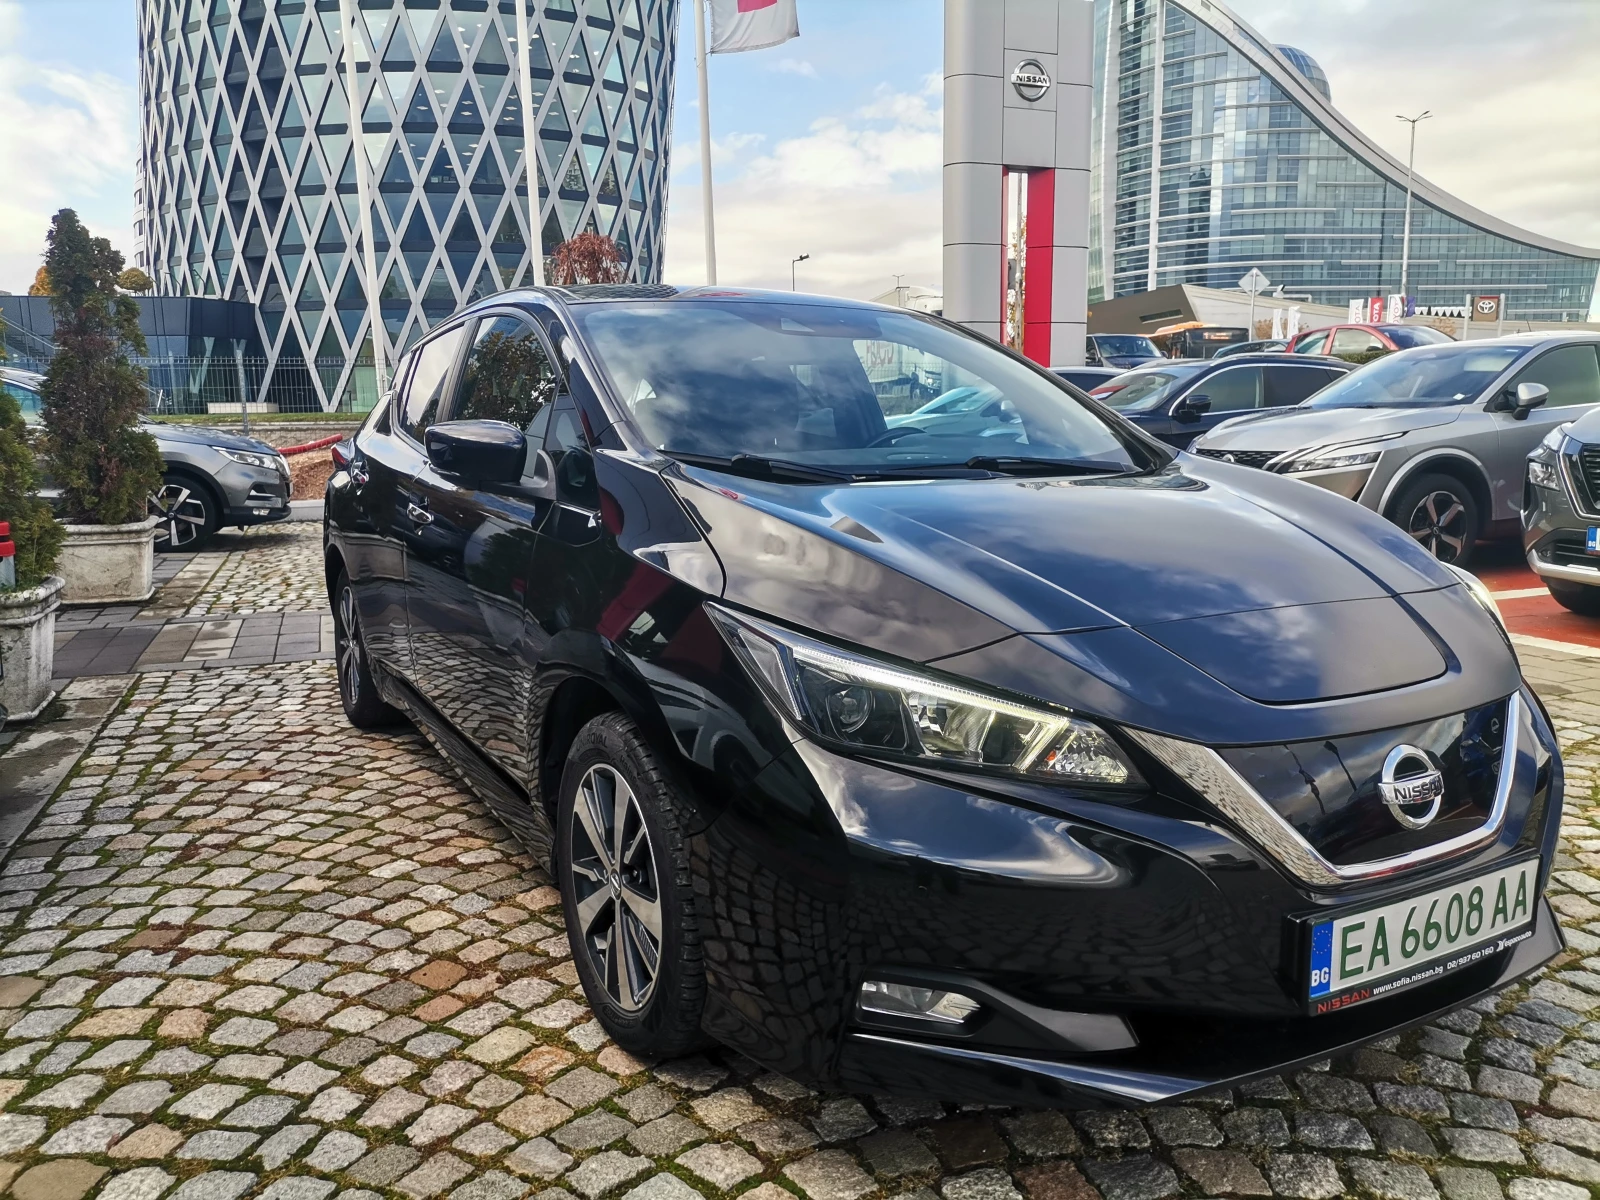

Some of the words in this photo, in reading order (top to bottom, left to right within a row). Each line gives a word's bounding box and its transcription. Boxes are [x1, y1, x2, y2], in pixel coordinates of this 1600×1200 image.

[1016, 75, 1048, 85] NISSAN
[1372, 302, 1381, 322] OTA
[1394, 775, 1443, 800] NISSAN
[1340, 916, 1390, 980] EA
[1401, 885, 1484, 959] 6608
[1490, 869, 1527, 929] AA
[1311, 967, 1329, 987] BG
[1317, 988, 1370, 1014] NISSAN
[1373, 965, 1444, 995] www.sofia.nissan.bg
